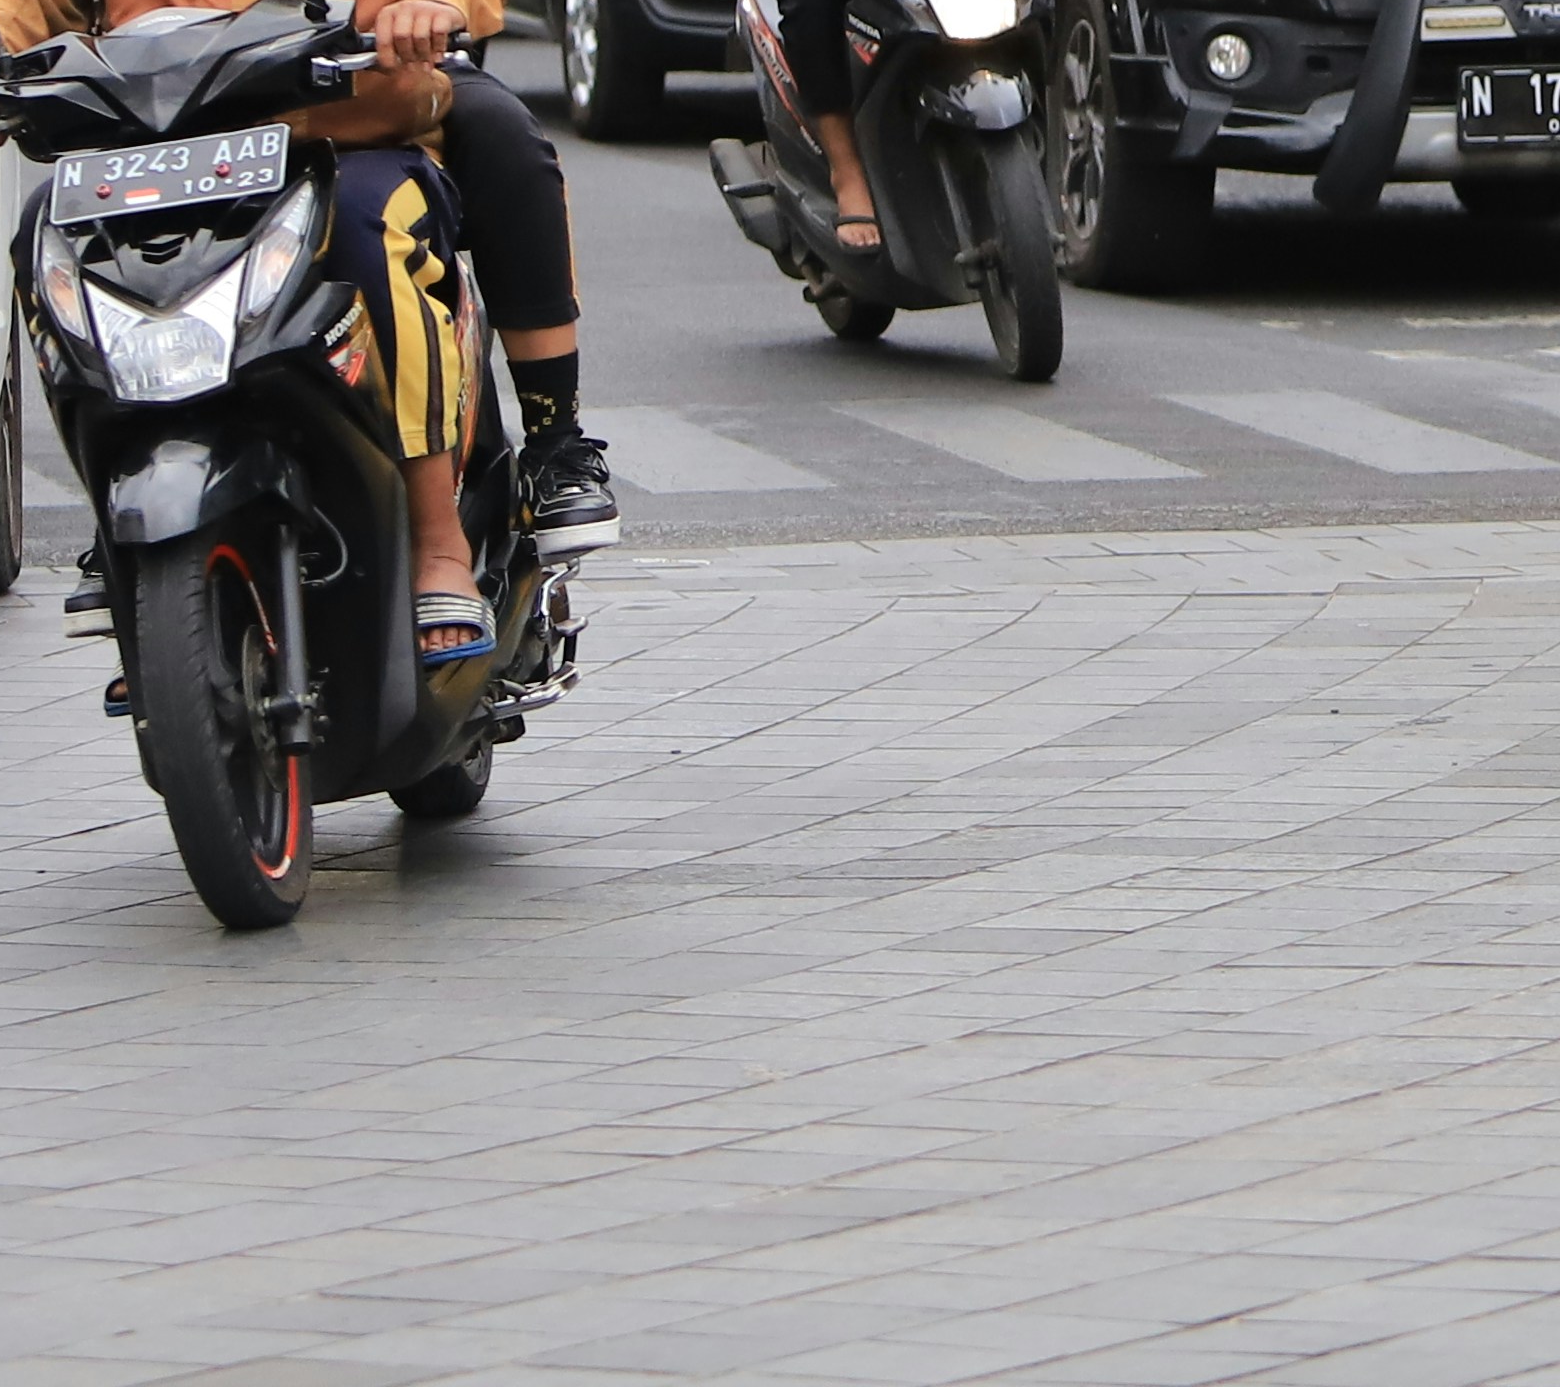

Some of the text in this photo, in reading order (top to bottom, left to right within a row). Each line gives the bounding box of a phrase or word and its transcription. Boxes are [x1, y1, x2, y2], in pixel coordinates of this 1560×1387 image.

[1472, 75, 1493, 117] N
[62, 131, 281, 188] N 3243 AAB
